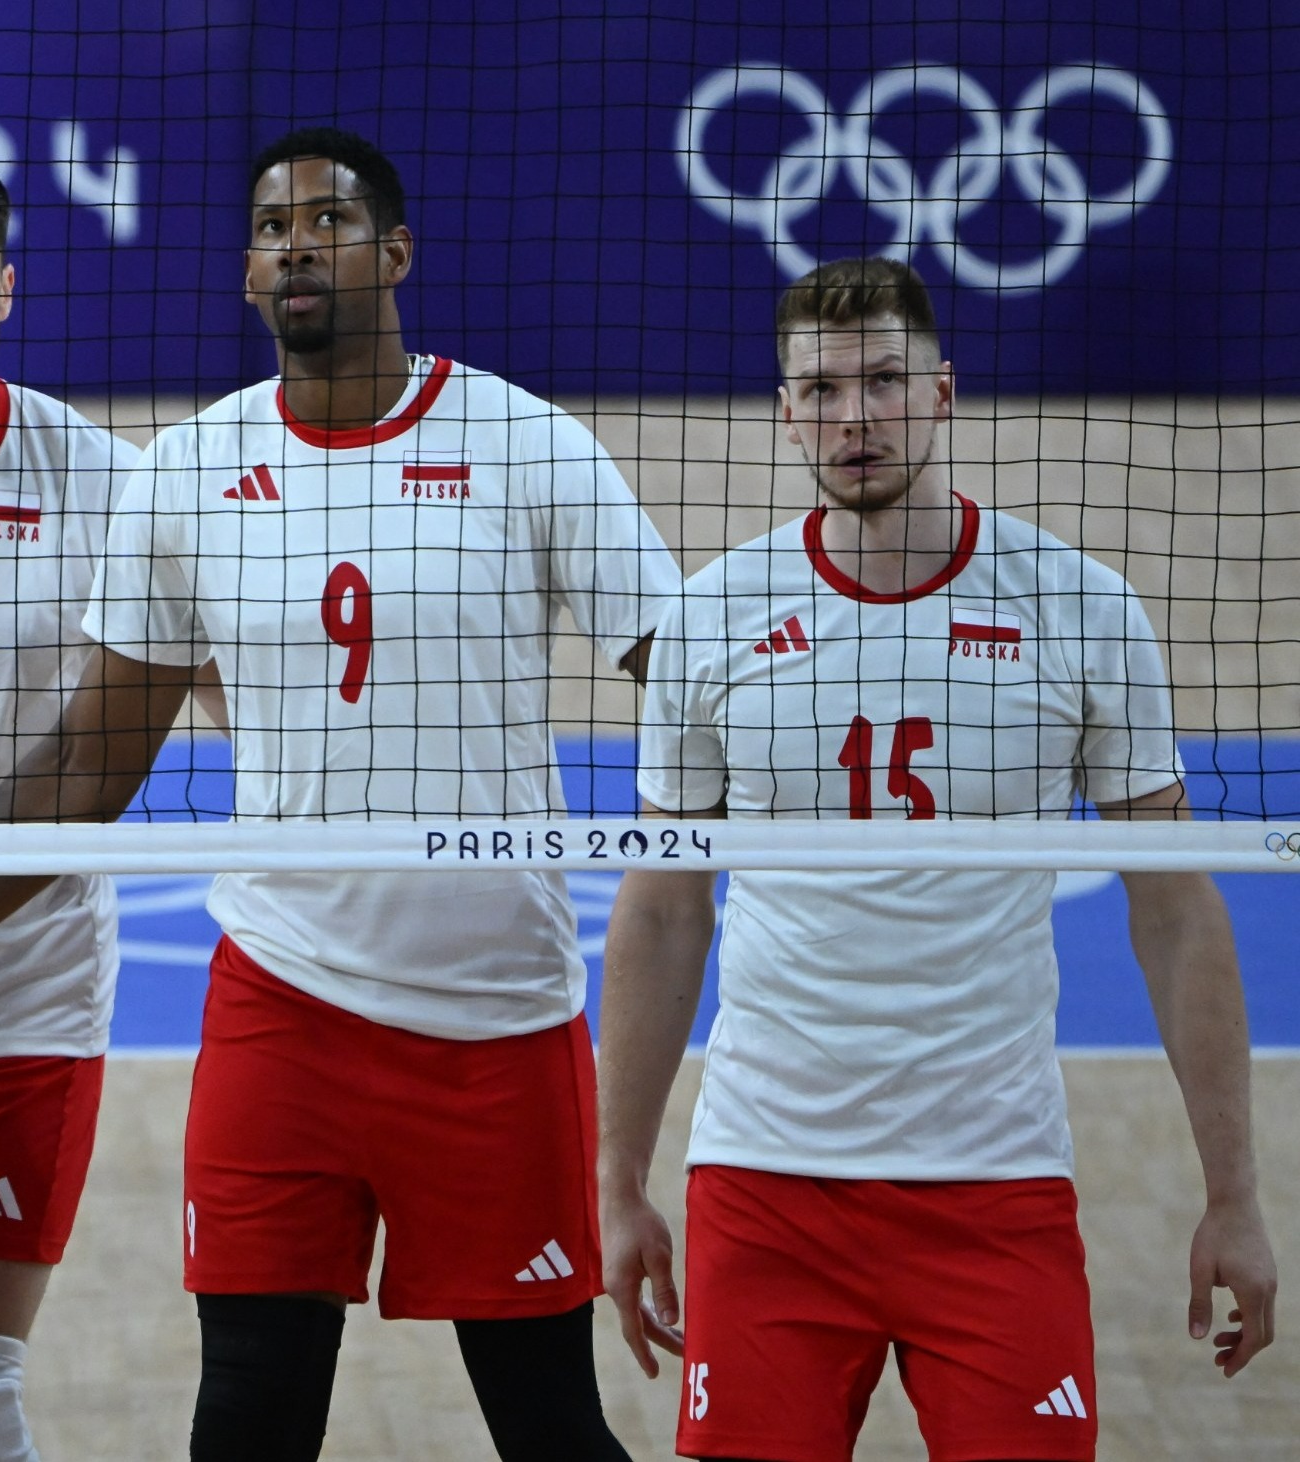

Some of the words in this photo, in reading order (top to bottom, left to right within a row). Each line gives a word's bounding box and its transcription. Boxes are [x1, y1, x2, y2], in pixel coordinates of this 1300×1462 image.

[402, 482, 471, 499] POLSKA
[321, 561, 372, 704] 9
[950, 640, 1020, 663] POLSKA
[838, 715, 936, 820] 15
[588, 829, 711, 859] 2024
[688, 1362, 709, 1421] 15
